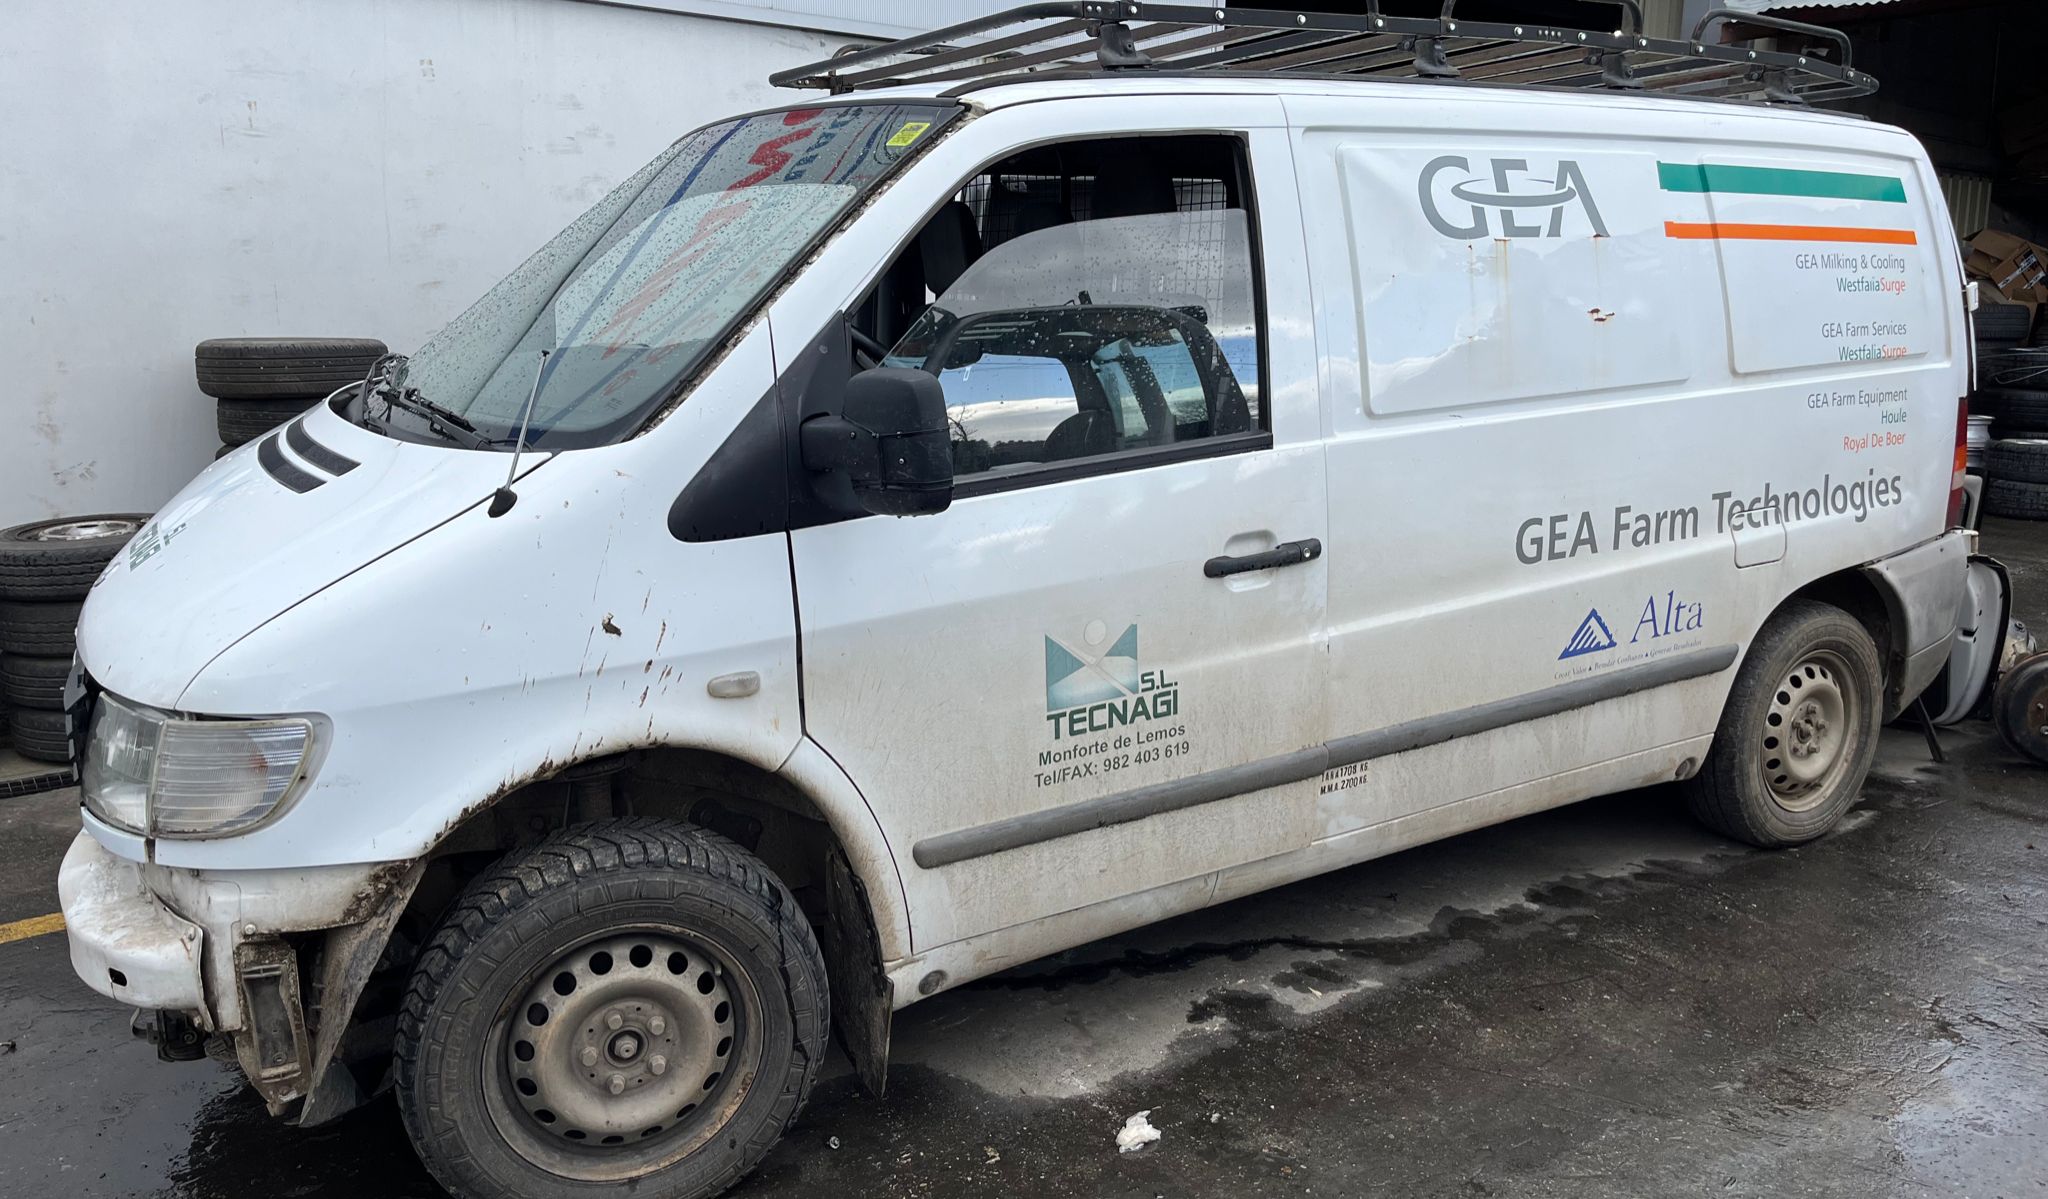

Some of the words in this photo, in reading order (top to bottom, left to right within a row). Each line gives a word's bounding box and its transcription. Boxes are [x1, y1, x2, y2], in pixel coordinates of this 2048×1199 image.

[1418, 155, 1610, 240] GEA
[1795, 253, 1819, 270] GEA
[1820, 253, 1857, 273] Milking
[1860, 254, 1868, 270] &
[1870, 253, 1905, 273] Cooling
[1821, 322, 1844, 339] GEA
[1845, 322, 1869, 337] Farm
[1872, 320, 1907, 336] Services
[1807, 393, 1829, 409] GEA
[1831, 392, 1856, 407] Farm
[1858, 387, 1908, 407] Equipment
[1881, 408, 1907, 425] Houle
[1843, 433, 1869, 453] Royal
[1871, 433, 1884, 448] De
[1886, 431, 1906, 446] Boer
[1515, 511, 1599, 565] GEA
[1612, 505, 1698, 551] Farm
[1711, 467, 1902, 534] Technologies
[1629, 589, 1703, 644] Alta
[1140, 669, 1178, 693] S.L.
[1046, 689, 1179, 740] TECNAGI
[1038, 744, 1109, 767] Monforte
[1113, 735, 1132, 750] de
[1136, 724, 1186, 745] Lemos
[1034, 762, 1099, 788] Tel/FAX:
[1103, 754, 1130, 773] 982
[1134, 747, 1160, 766] 403
[1164, 740, 1190, 758] 619
[1341, 776, 1358, 789] 2700
